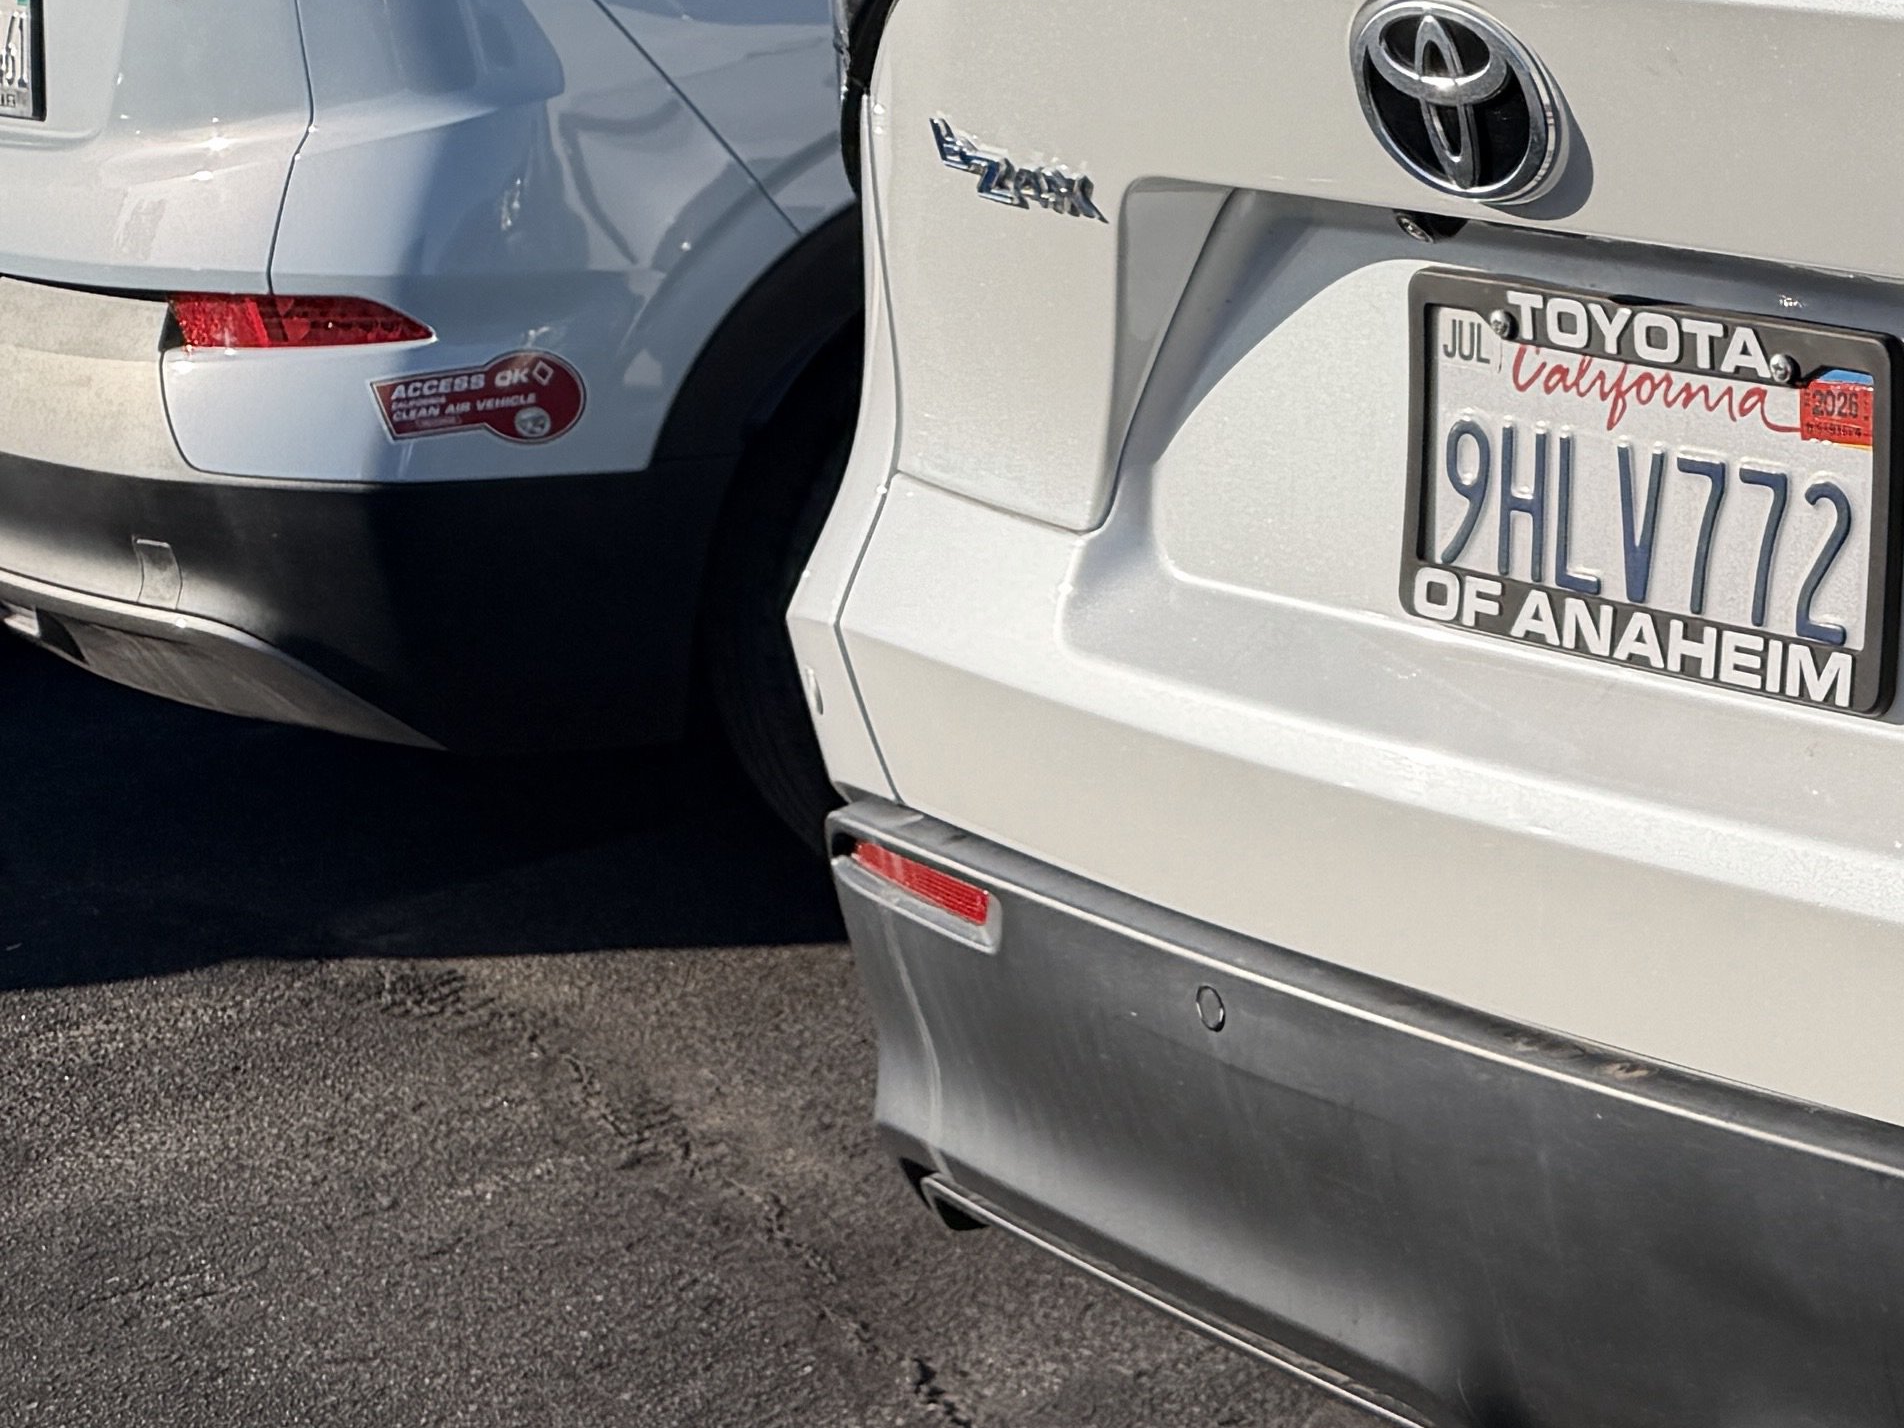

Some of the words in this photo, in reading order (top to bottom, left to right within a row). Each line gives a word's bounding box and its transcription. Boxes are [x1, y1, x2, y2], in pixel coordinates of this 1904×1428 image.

[1442, 318, 1491, 365] JUL
[1506, 290, 1771, 380] TOYOTA
[391, 374, 485, 400] ACCESS
[494, 367, 529, 387] OK
[392, 404, 440, 422] CLEAN
[445, 400, 471, 415] AIR
[475, 392, 537, 412] VEHICLE
[1512, 344, 1801, 431] California
[1812, 390, 1859, 419] 2026
[1440, 408, 1852, 646] 9HLV772
[1413, 566, 1503, 628] OF
[1510, 588, 1854, 708] ANAHEIM
